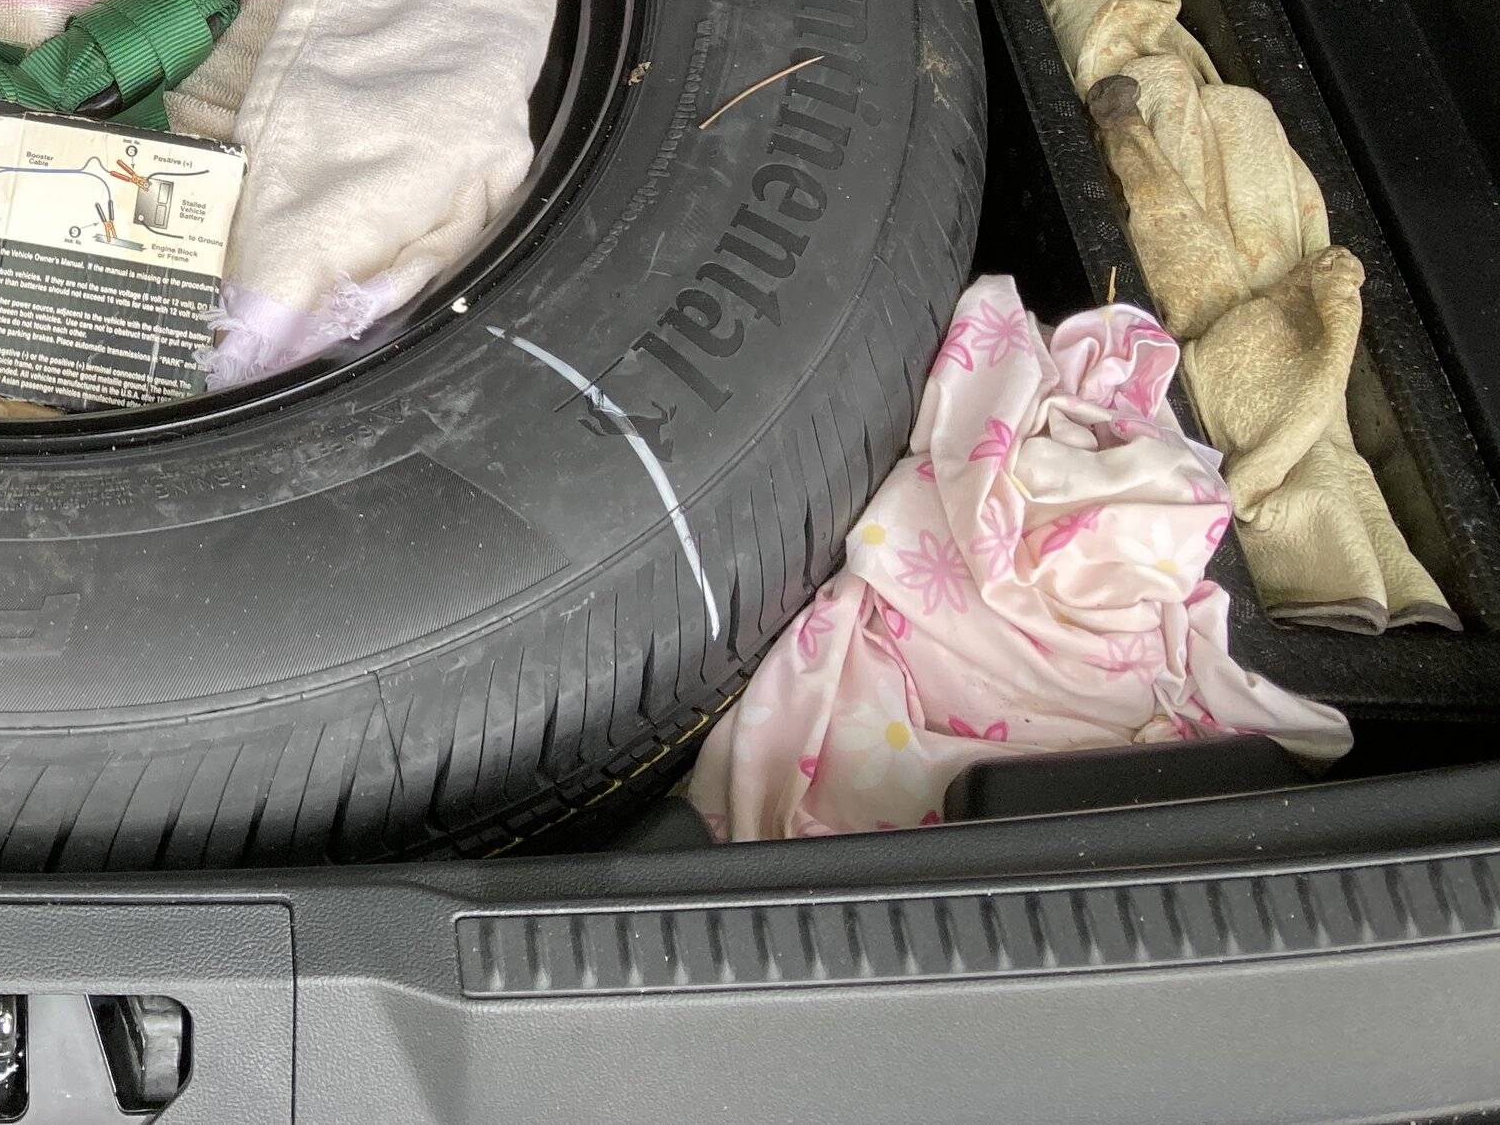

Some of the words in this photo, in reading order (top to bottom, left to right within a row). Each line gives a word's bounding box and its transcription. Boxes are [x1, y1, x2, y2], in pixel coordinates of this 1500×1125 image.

[26, 151, 55, 162] Booster
[28, 158, 49, 167] Cable
[153, 154, 181, 165] Positive
[180, 205, 206, 216] Vehicle
[182, 199, 207, 210] Stalled
[179, 211, 205, 223] Battery
[197, 235, 224, 248] Ground
[151, 243, 176, 255] Engine
[177, 247, 198, 258] Block
[166, 253, 190, 263] Frame
[0, 247, 10, 256] the
[10, 249, 33, 260] Vehicle
[33, 253, 60, 264] Owner's
[60, 258, 85, 268] Manual.
[92, 263, 104, 272] the
[104, 265, 128, 276] manual
[135, 271, 161, 284] missing
[169, 277, 181, 286] the
[180, 279, 214, 294] procedure
[4, 277, 19, 286] than
[19, 280, 47, 291] batteries
[47, 285, 70, 295] should
[70, 289, 82, 297] not
[82, 291, 105, 302] exceed
[114, 297, 131, 306] volts
[131, 300, 141, 308] for
[141, 303, 154, 311] use
[154, 304, 168, 313] with
[177, 308, 191, 317] volt
[10, 300, 31, 310] power
[55, 307, 83, 319] adjacent
[91, 313, 103, 322] the
[102, 315, 126, 326] vehicle
[126, 319, 141, 329] with
[140, 322, 152, 331] the
[152, 324, 188, 339] discharged
[21, 319, 33, 328] not
[32, 321, 52, 331] touch
[51, 325, 68, 334] each
[68, 328, 87, 338] other.
